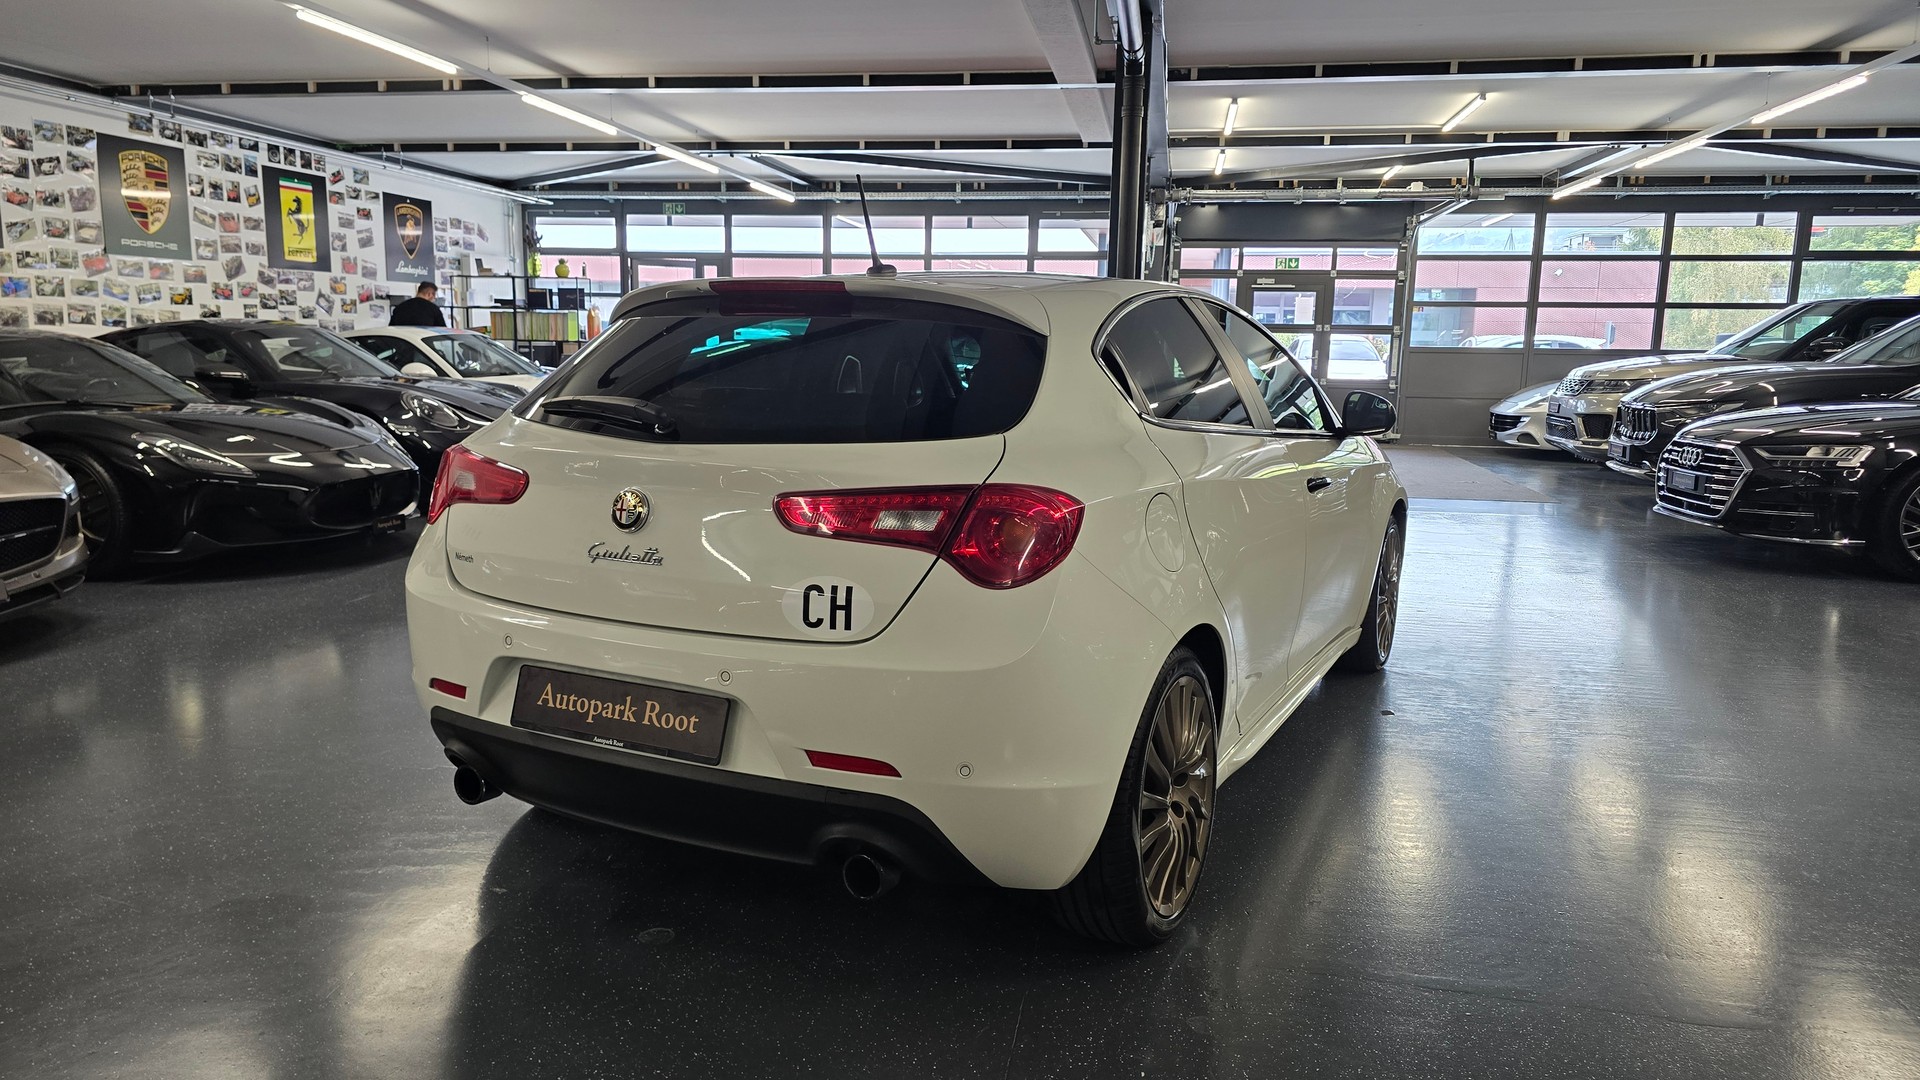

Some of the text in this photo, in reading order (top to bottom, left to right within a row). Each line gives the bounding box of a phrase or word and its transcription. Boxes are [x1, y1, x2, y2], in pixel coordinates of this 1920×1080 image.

[121, 152, 166, 168] PORSCHE
[121, 238, 178, 250] PORSCHE
[287, 246, 315, 258] Ferrari
[395, 260, 429, 277] Lamborghini
[588, 542, 664, 566] Giulietta
[802, 584, 853, 631] CH
[536, 682, 700, 735] Autopark Root
[592, 736, 624, 747] Autopark Root
